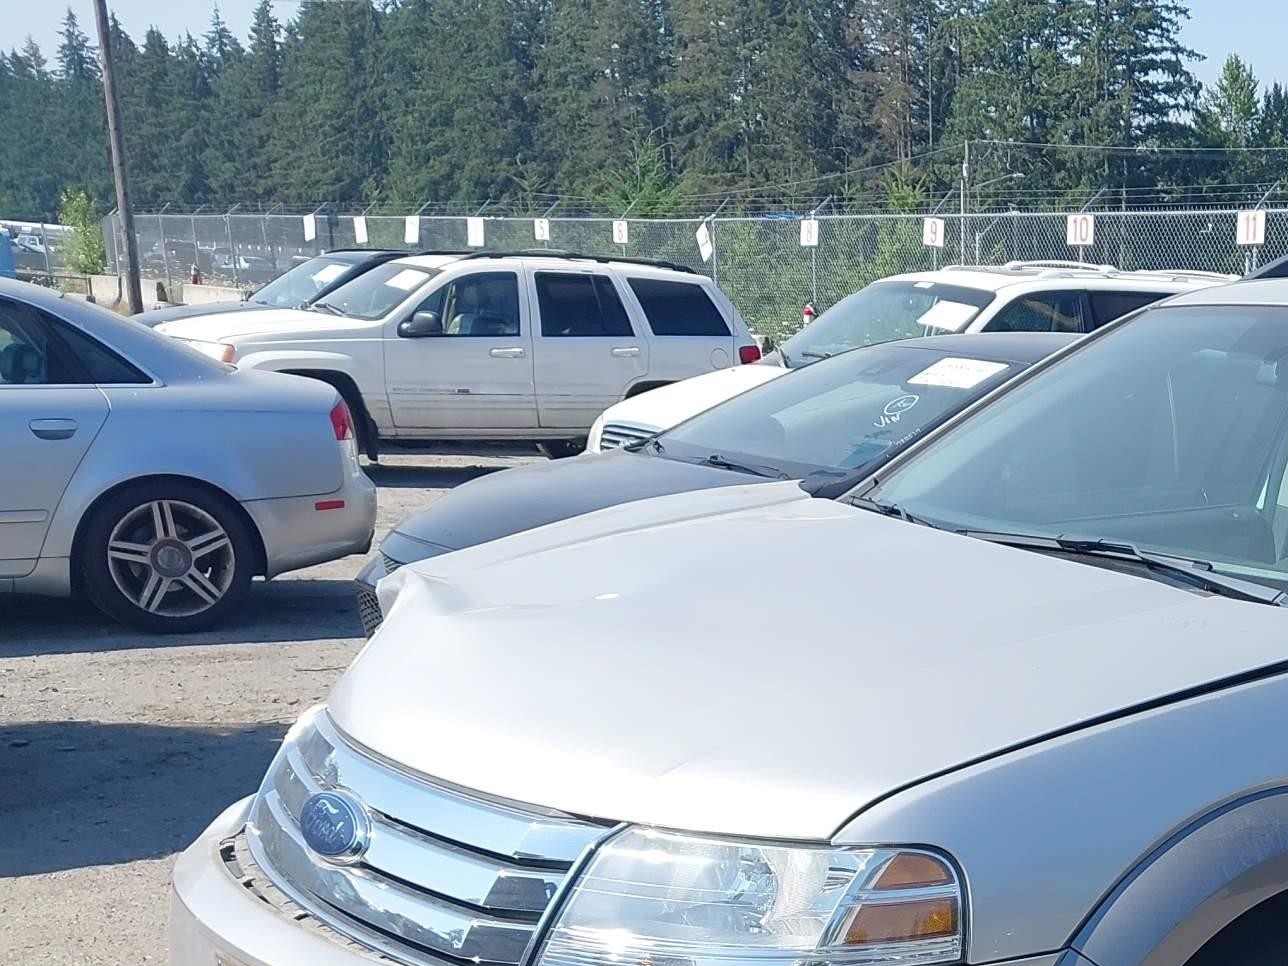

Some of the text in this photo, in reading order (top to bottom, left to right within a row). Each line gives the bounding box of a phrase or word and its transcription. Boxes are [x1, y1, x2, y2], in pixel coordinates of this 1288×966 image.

[930, 221, 937, 244] 9
[1072, 217, 1089, 242] 10
[1245, 215, 1258, 242] 11
